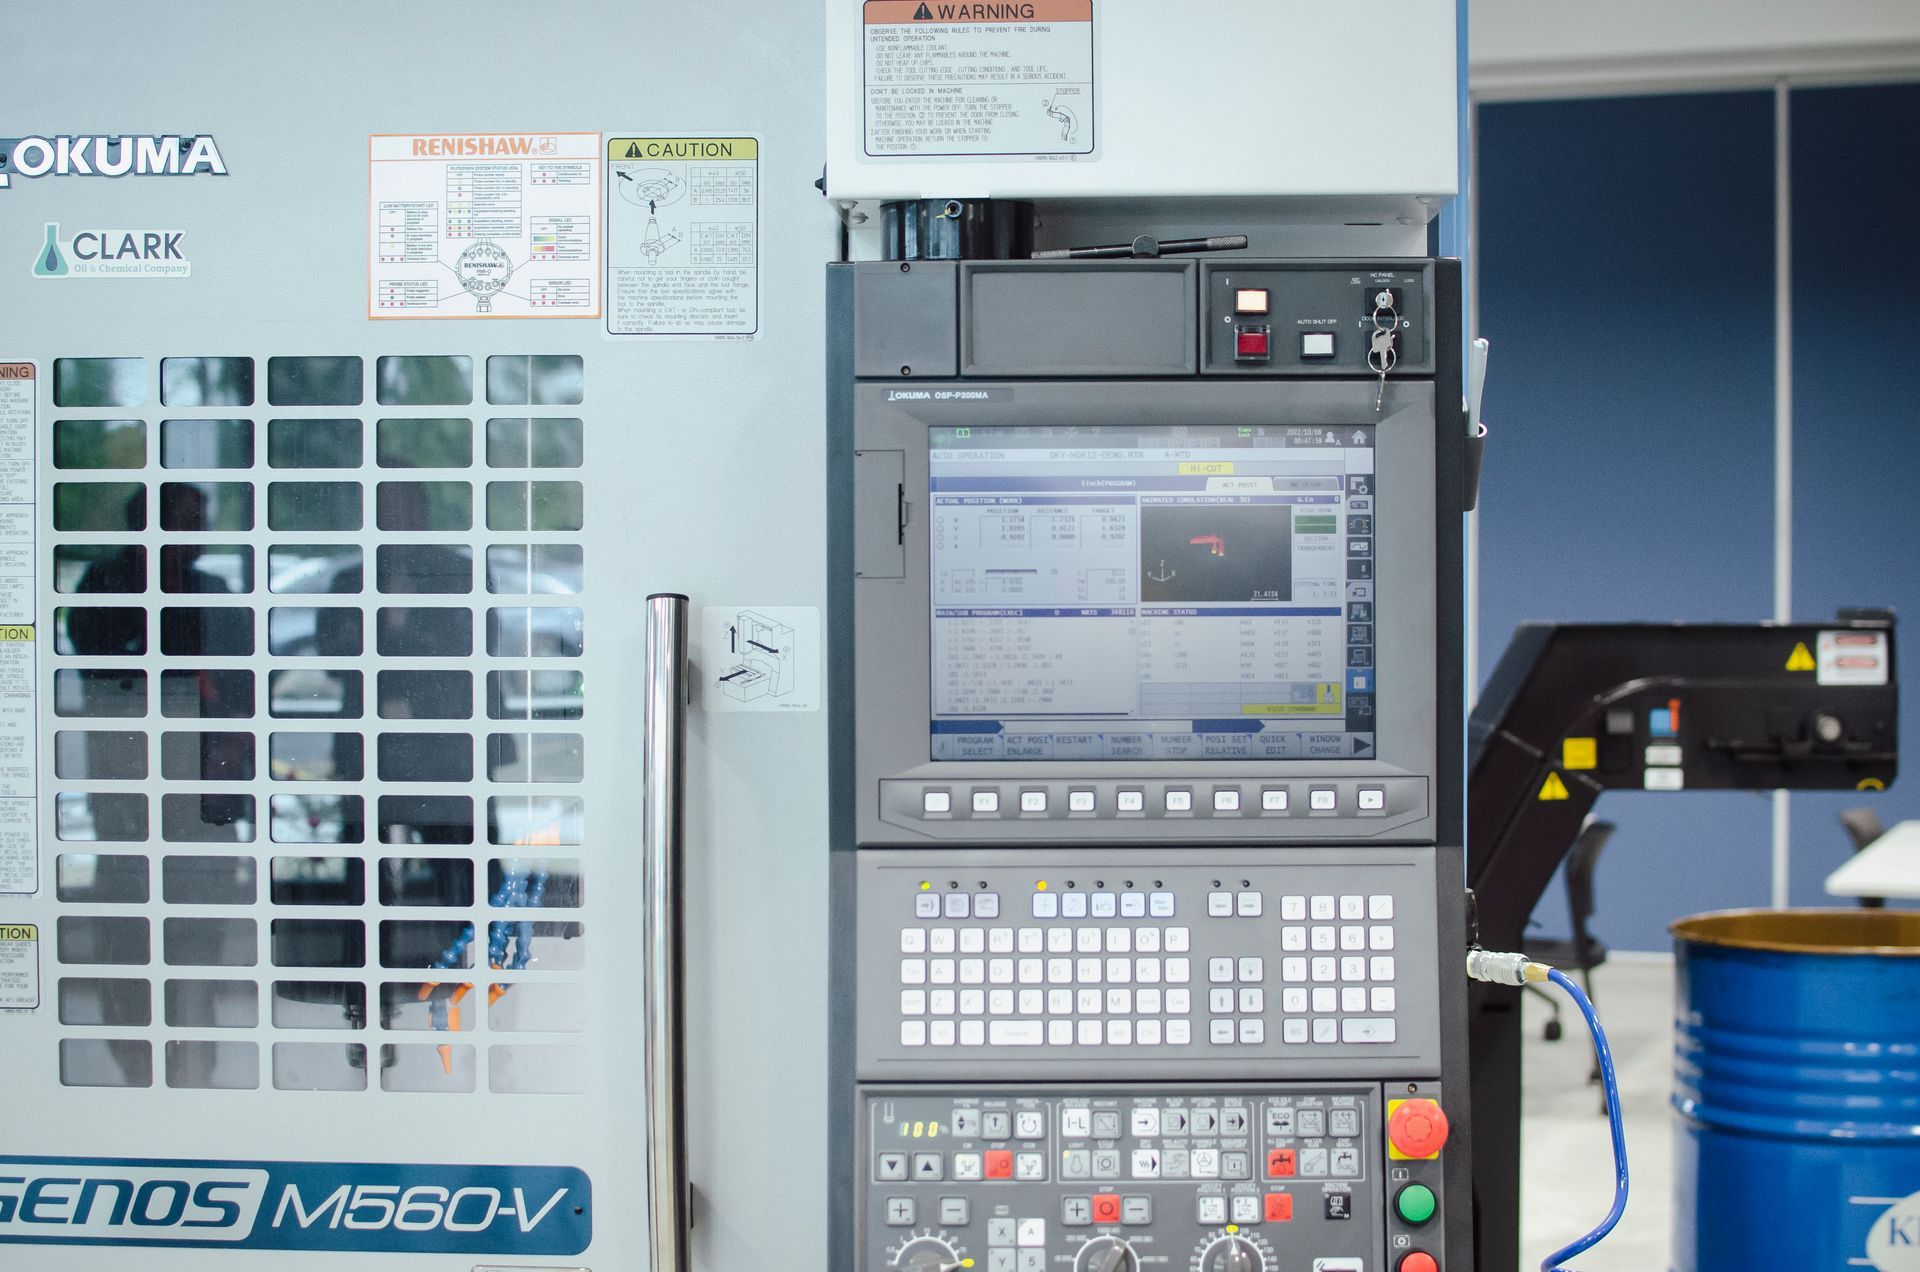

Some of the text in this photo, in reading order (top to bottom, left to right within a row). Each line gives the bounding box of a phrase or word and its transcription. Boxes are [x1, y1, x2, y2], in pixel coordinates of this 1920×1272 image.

[938, 4, 1035, 19] WARNING
[647, 143, 732, 157] CAUTION
[13, 137, 227, 176] OKUMA
[73, 233, 183, 260] CLARK
[74, 264, 87, 273] Oil
[99, 264, 141, 273] Chemical
[144, 264, 187, 274] Company
[1291, 904, 1298, 912] 7
[1319, 903, 1327, 912] 8
[1348, 903, 1356, 912] 9
[1291, 934, 1298, 942] 4
[1320, 934, 1327, 942] 5
[1349, 934, 1356, 942] 6
[1292, 965, 1296, 974] 1
[1320, 965, 1328, 974] 2
[1350, 965, 1357, 974] 3
[1291, 996, 1299, 1004] 0
[272, 1183, 568, 1232] M560-V
[998, 1227, 1006, 1237] X
[1890, 1218, 1920, 1245] K
[999, 1257, 1006, 1267] Y
[1028, 1257, 1035, 1266] 5
